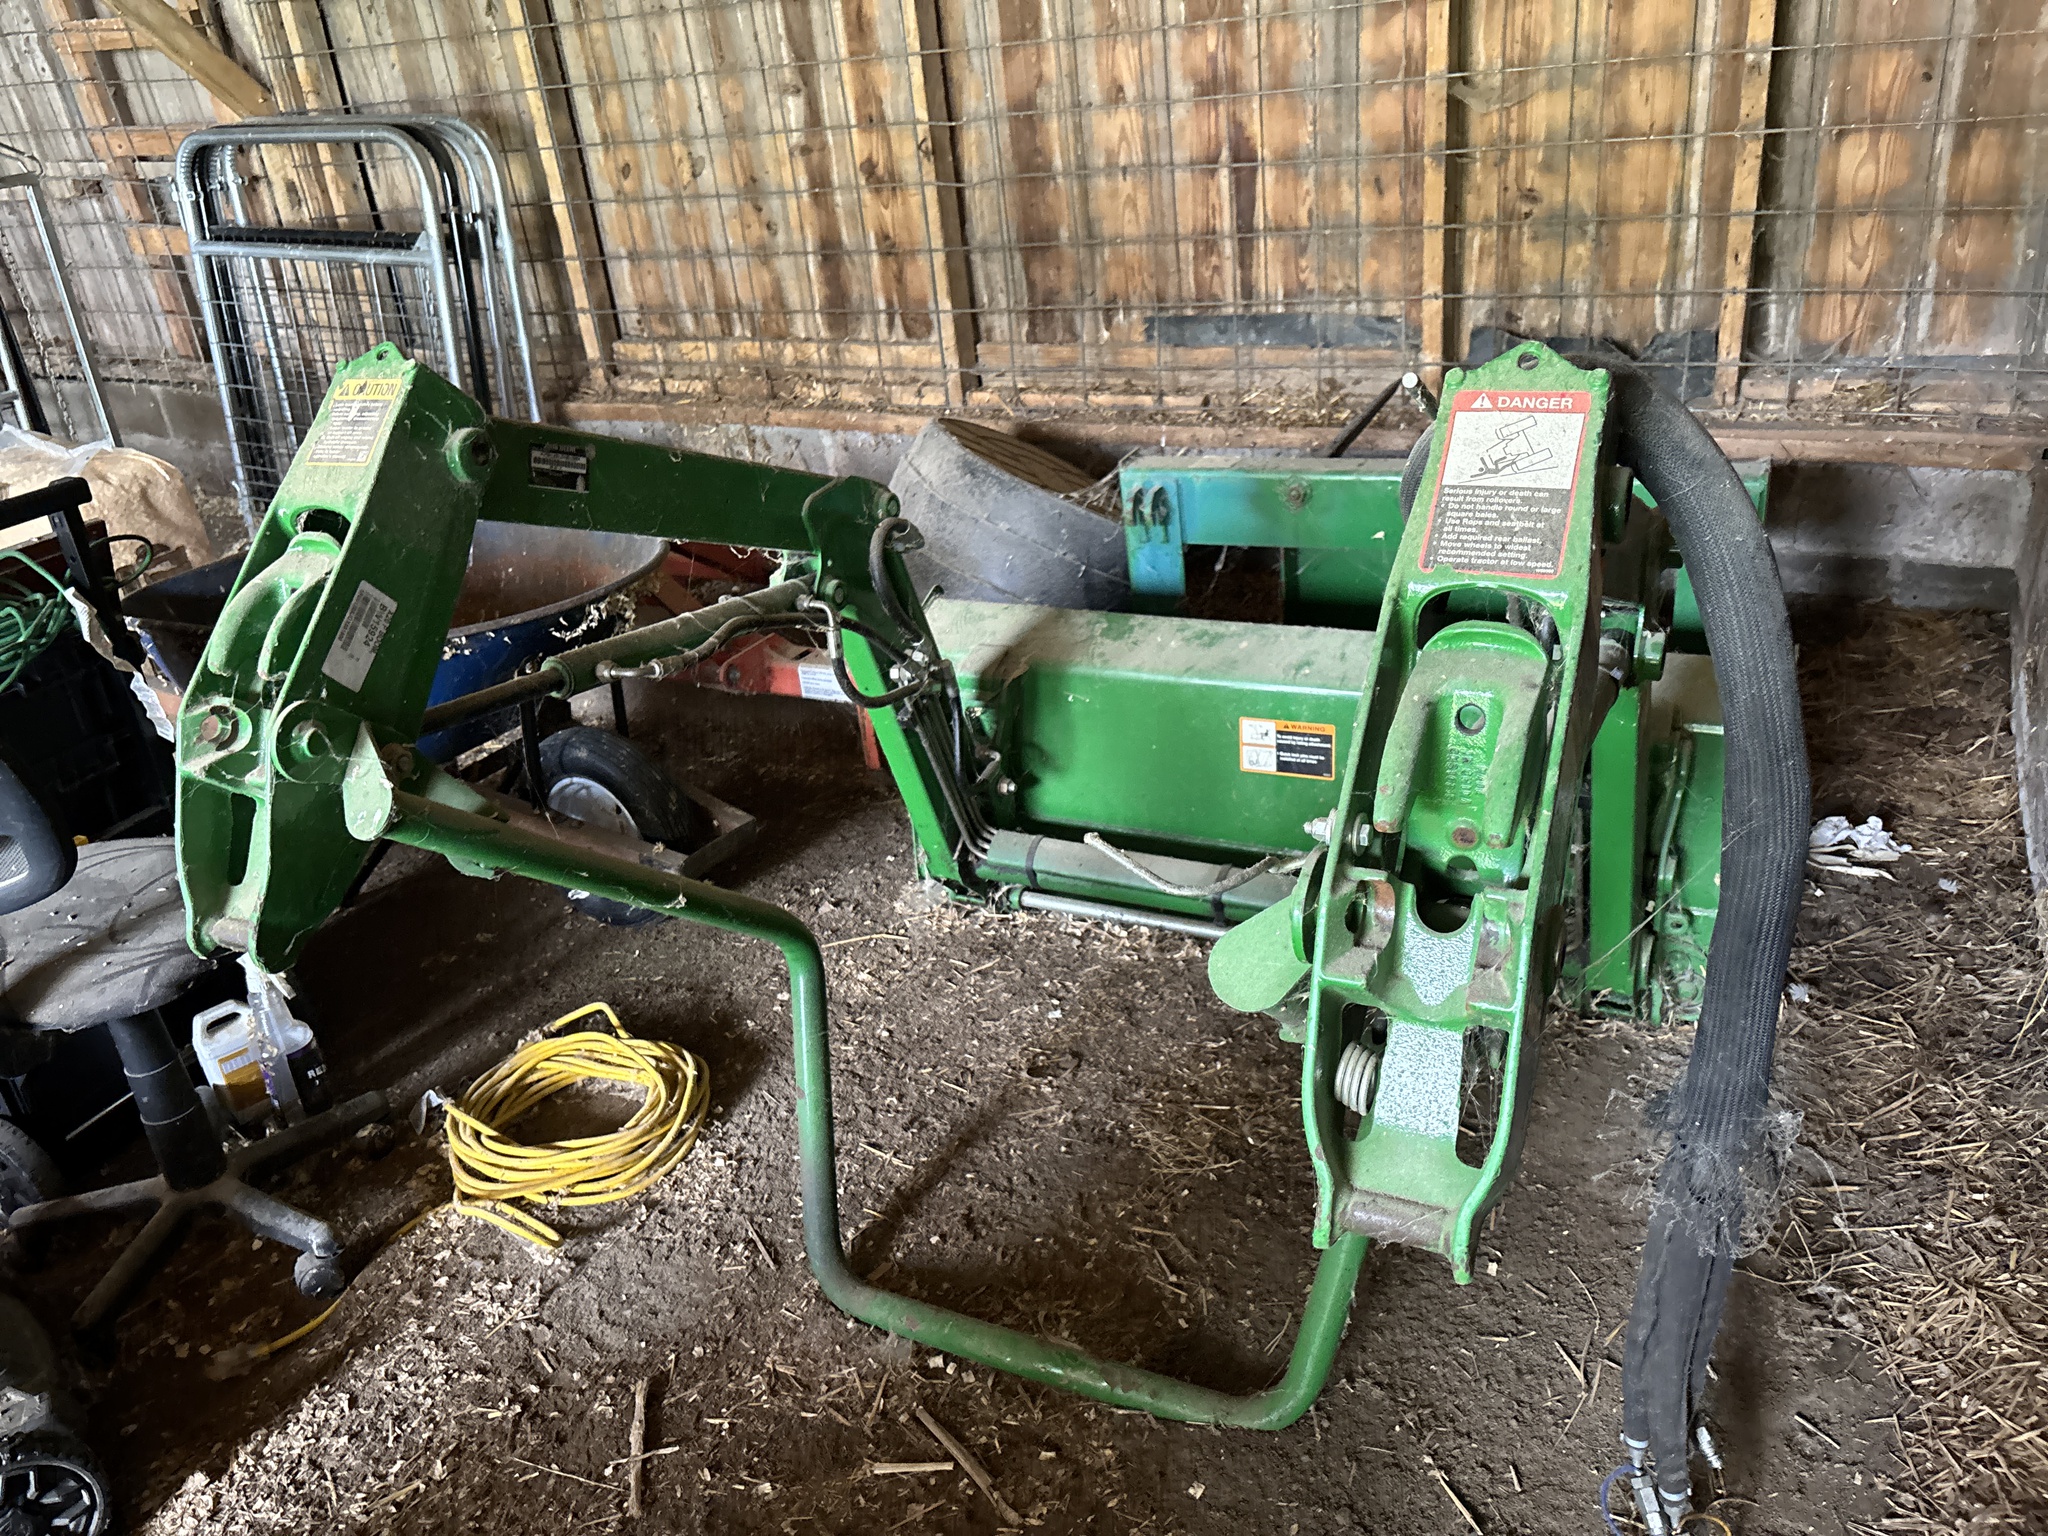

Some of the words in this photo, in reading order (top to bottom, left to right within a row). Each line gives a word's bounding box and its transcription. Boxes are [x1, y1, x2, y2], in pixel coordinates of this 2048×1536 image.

[1498, 396, 1573, 409] DANGER
[1541, 506, 1561, 514] large
[1459, 534, 1493, 542] required
[1497, 551, 1528, 559] setting.
[1437, 556, 1469, 564] Operate
[363, 603, 388, 647] BW15924
[1291, 724, 1326, 732] WARNING
